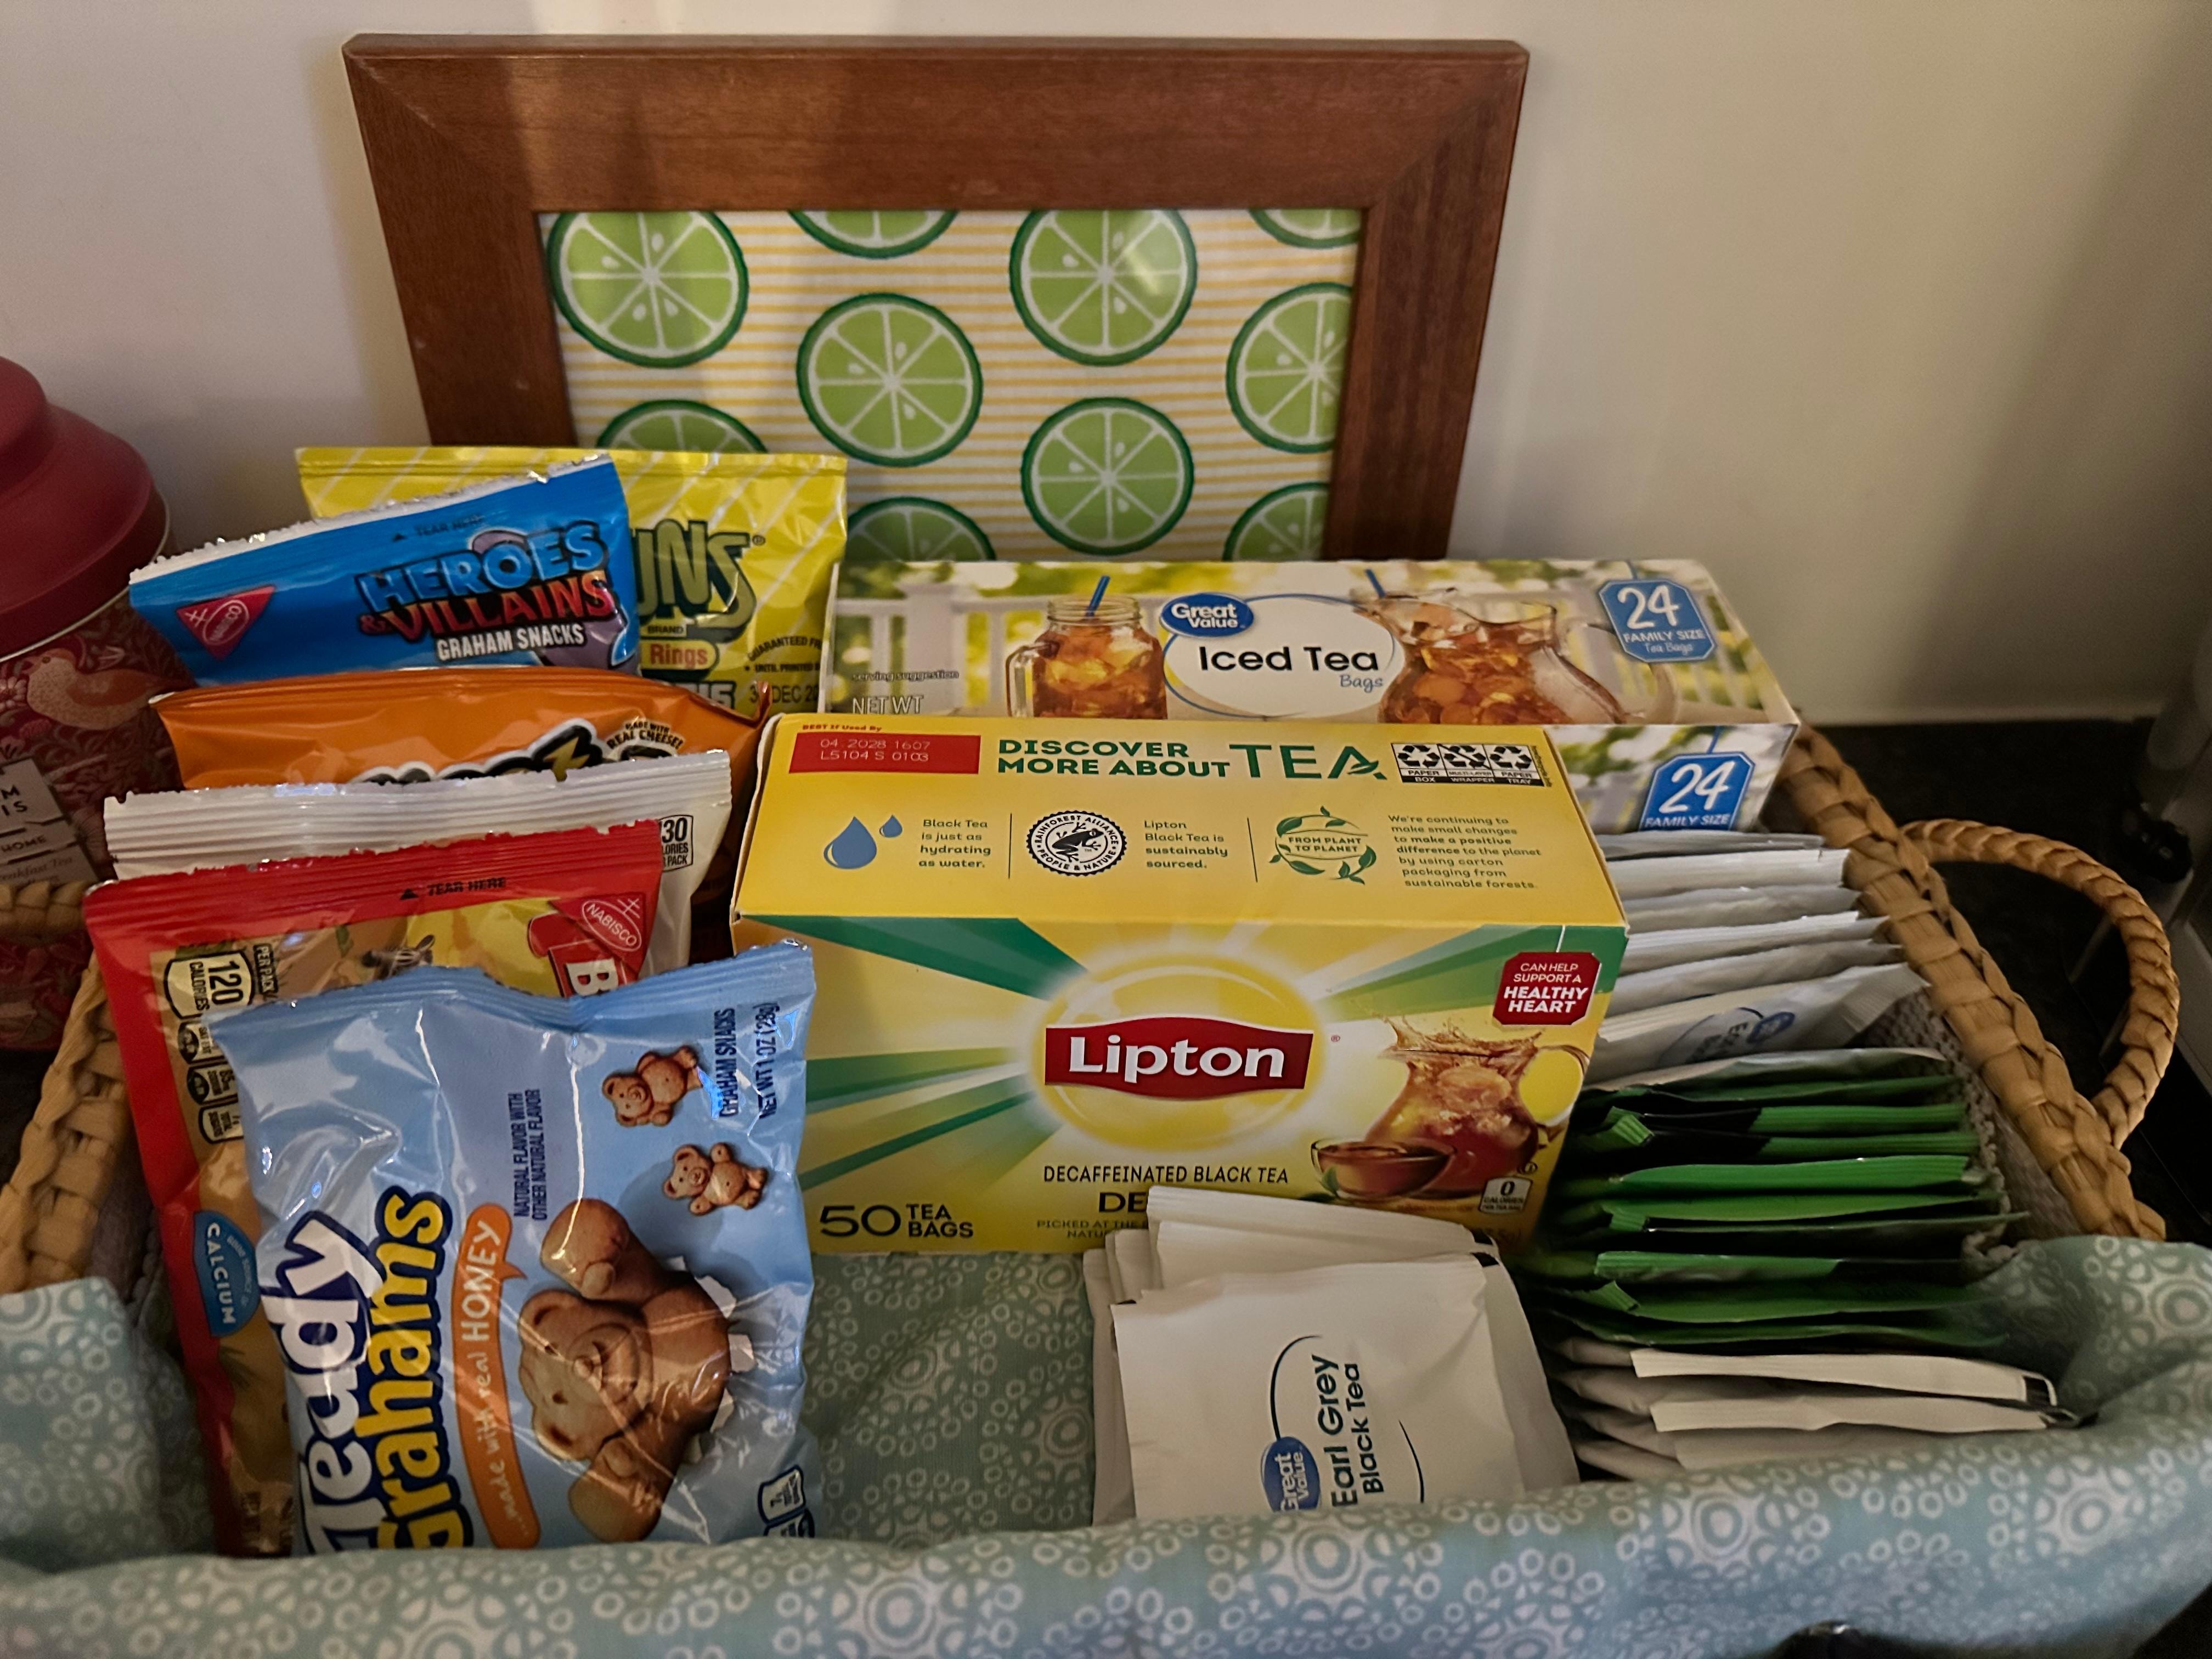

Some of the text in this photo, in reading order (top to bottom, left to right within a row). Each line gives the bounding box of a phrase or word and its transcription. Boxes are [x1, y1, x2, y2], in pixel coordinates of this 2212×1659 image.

[357, 521, 608, 610] HEROES
[631, 520, 756, 636] UNS
[380, 571, 616, 643] VILLAINS
[1171, 603, 1238, 619] Great
[1617, 585, 1679, 629] 24
[647, 626, 684, 634] BRAND
[1188, 615, 1238, 628] Value
[438, 624, 585, 661] GRAHAM SNACKS
[1623, 629, 1705, 642] FAMILY SIZE
[650, 644, 708, 669] Rings
[748, 637, 808, 661] GUARANTEED
[1199, 646, 1379, 671] Iced Tea
[1645, 642, 1694, 656] Tea Bags
[851, 669, 959, 682] serving suggestion
[1339, 674, 1383, 693] Bags
[772, 685, 802, 703] DEC
[853, 695, 924, 714] NET WT
[649, 723, 670, 734] WITH
[607, 730, 684, 750] REAL CHEESE!
[820, 738, 930, 750] 04 2028 1607
[998, 739, 1189, 758] DISCOVER
[820, 751, 868, 761] L5104
[892, 751, 929, 762] 0103
[1229, 744, 1387, 780] TEA
[997, 758, 1230, 777] MORE ABOUT
[1658, 760, 1735, 814] 24
[923, 819, 988, 828] Black Tea
[1035, 815, 1119, 845] RAINFOREST ALLIANCE
[1144, 820, 1187, 830] Lipton
[1426, 817, 1493, 825] continuing
[1645, 814, 1730, 828] FAMILY SIZE
[922, 832, 932, 840] is
[935, 832, 962, 842] just
[1145, 833, 1224, 842] Black Tea is
[1465, 827, 1517, 836] changes
[919, 845, 991, 856] hydrating
[1460, 837, 1511, 846] positive
[668, 855, 688, 867] PACK
[1037, 850, 1070, 870] PEOPLE
[1084, 850, 1116, 871] NATURE
[1146, 847, 1228, 856] sustainably
[1399, 857, 1415, 865] by
[1502, 848, 1542, 856] planet
[940, 860, 985, 868] water.
[1147, 860, 1207, 868] sourced.
[1402, 868, 1471, 877] packaging
[427, 877, 506, 896] TEAR HERE
[1404, 879, 1537, 889] sustainable forests.
[586, 901, 638, 947] NABISCO
[255, 945, 276, 994] PER PACK
[1520, 963, 1578, 972] CAN HELP
[190, 962, 210, 1011] CALORIES
[208, 960, 244, 1006] 120
[1513, 974, 1582, 983] SUPPORT A
[1503, 986, 1588, 1000] HEALTHY
[1508, 1000, 1576, 1013] HEART
[757, 1036, 776, 1057] OZ
[1069, 1035, 1284, 1083] Lipton
[716, 1057, 738, 1118] GRAHAM
[756, 1069, 777, 1092] WT
[508, 1093, 528, 1217] NATURAL FLAVOR WITH
[524, 1090, 547, 1220] OTHER NATURAL FLAVOR
[1044, 1165, 1288, 1184] DECAFFEINATED BLACK TEA
[1500, 1181, 1515, 1196] 0
[906, 1204, 952, 1220] TEA
[1098, 1192, 1148, 1213] DE
[820, 1204, 901, 1238] 50
[908, 1222, 973, 1239] BAGS
[1037, 1220, 1090, 1229] PICKED
[1092, 1220, 1110, 1229] AT
[207, 1222, 236, 1324] CALCIUM
[460, 1221, 501, 1343] HONEY
[355, 1193, 463, 1549] Grahams
[468, 1352, 490, 1400] real
[262, 1215, 387, 1551] Teddy
[1311, 1354, 1358, 1507] Earl Grey
[1344, 1363, 1384, 1494] Black Tea
[1293, 1452, 1310, 1500] Value
